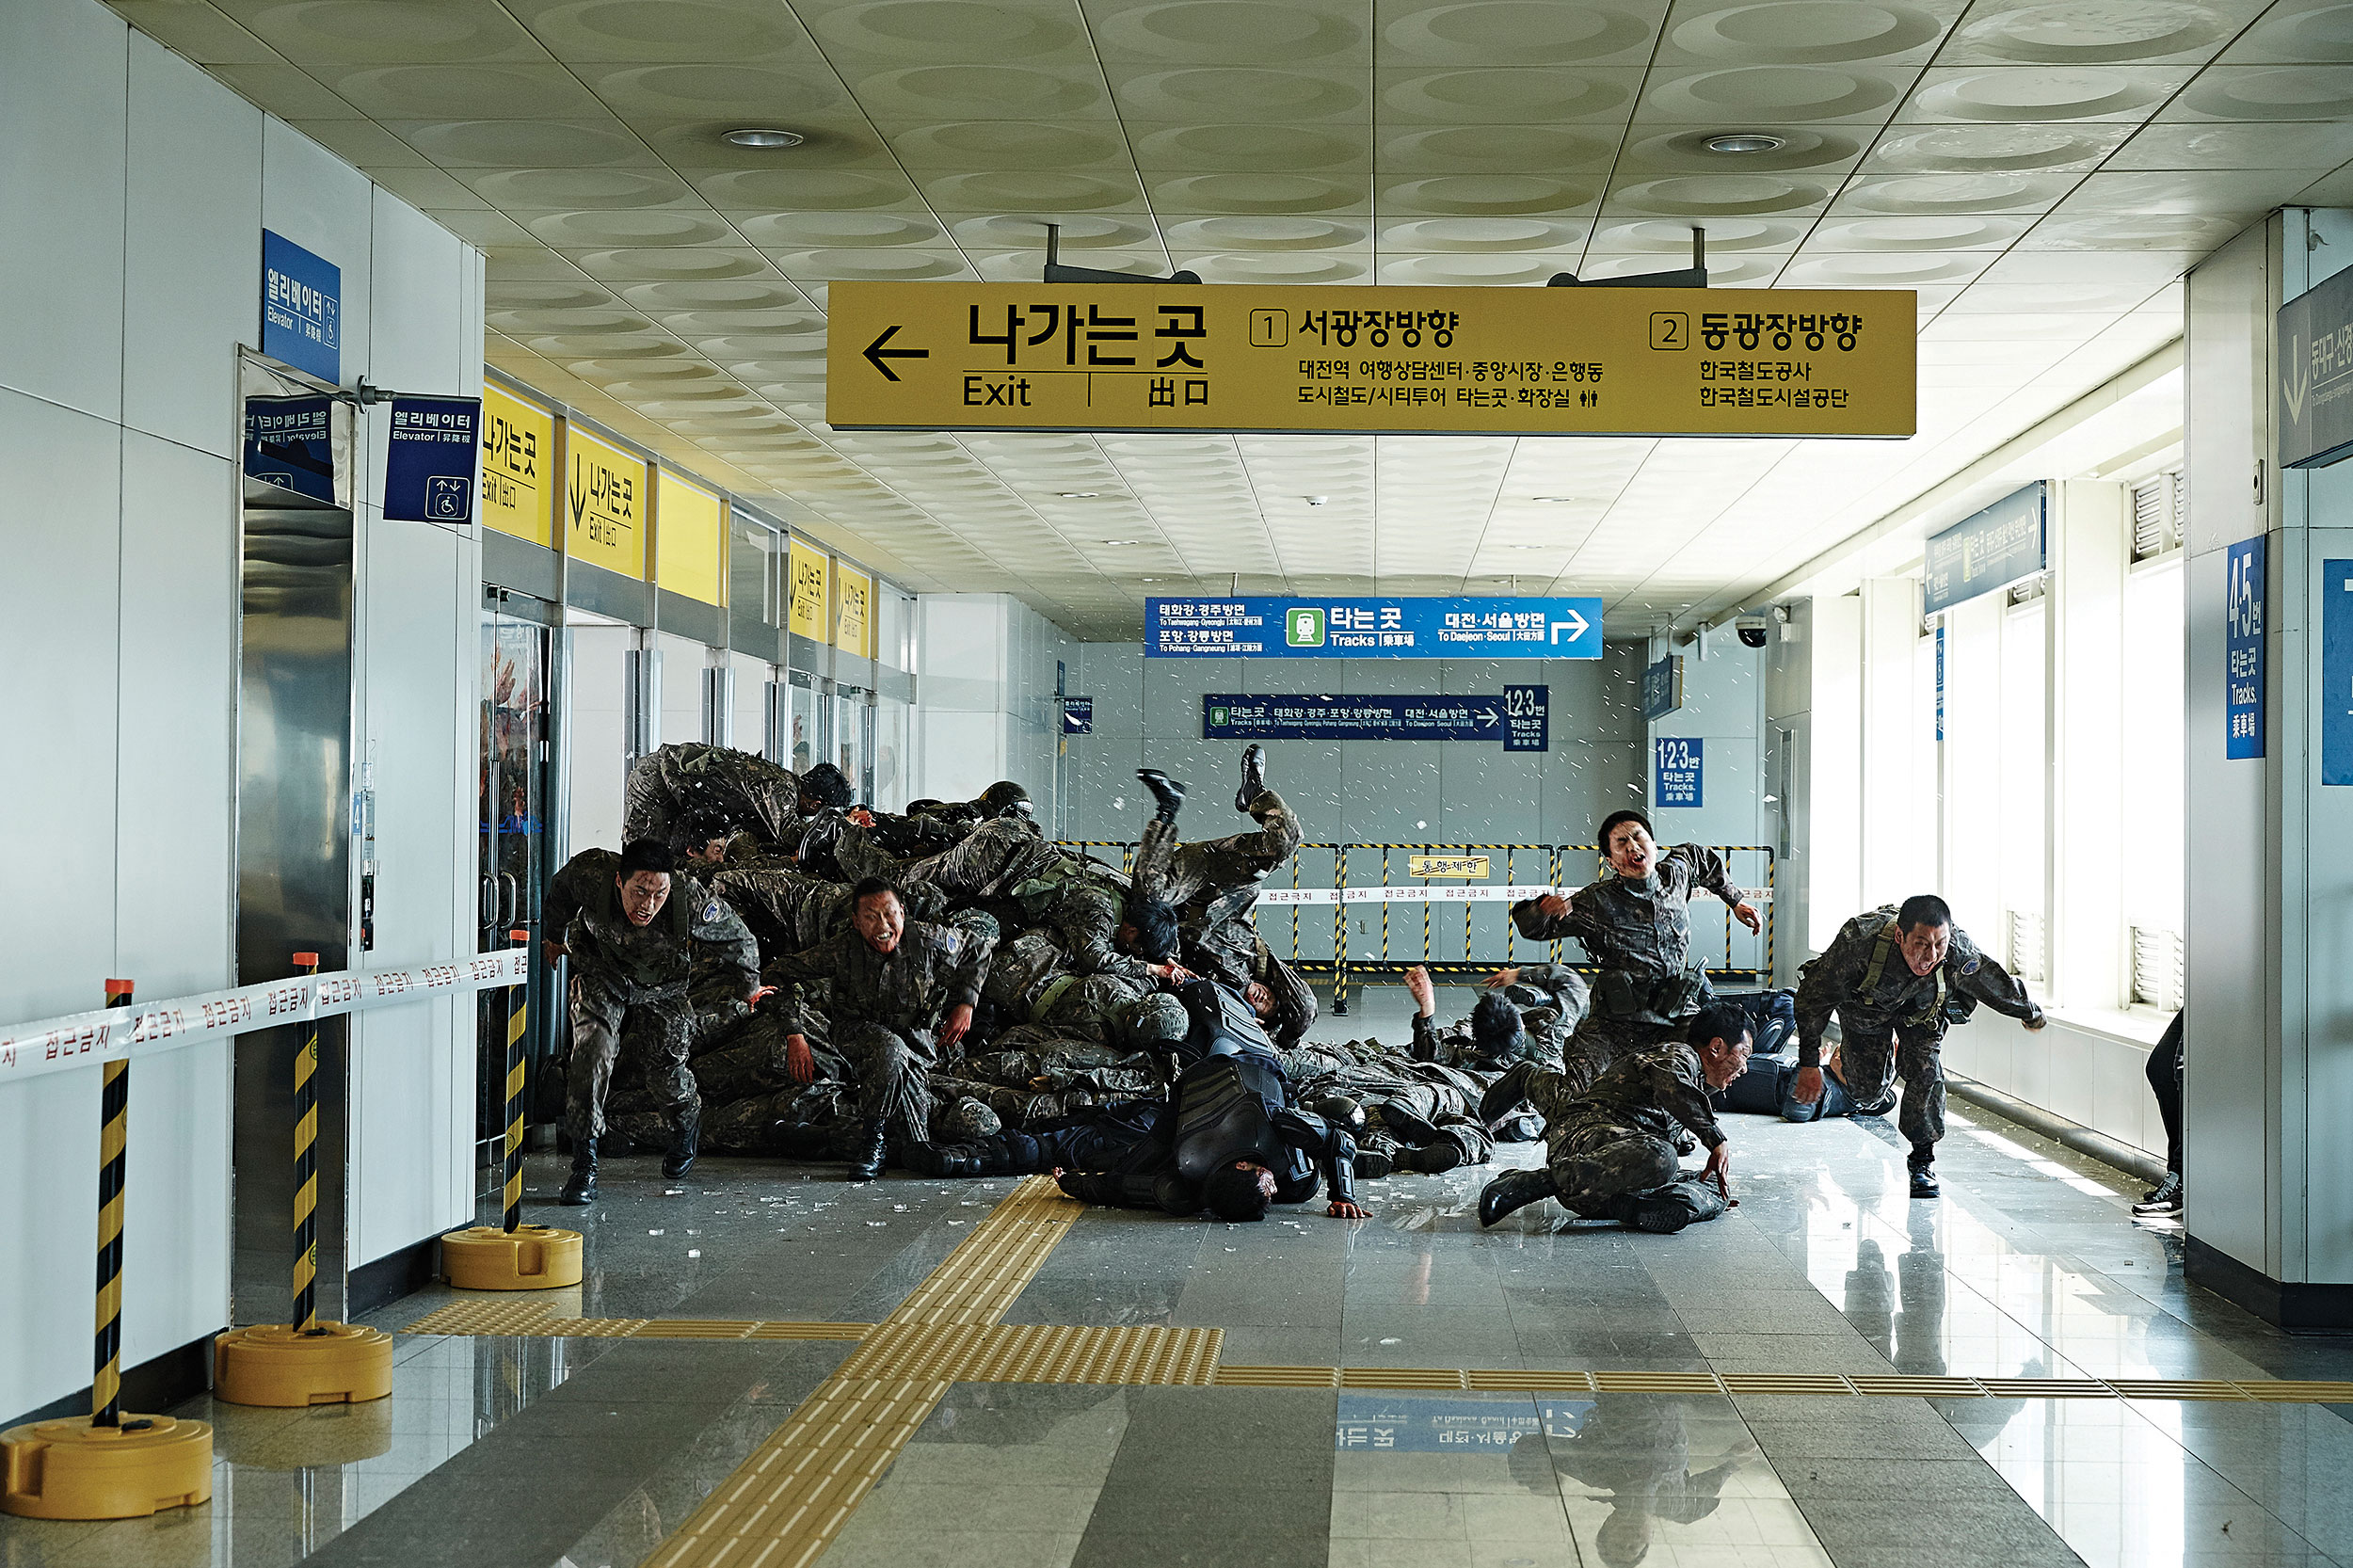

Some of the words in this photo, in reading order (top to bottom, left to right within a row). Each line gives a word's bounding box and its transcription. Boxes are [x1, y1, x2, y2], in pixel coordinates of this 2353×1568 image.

[267, 267, 322, 322] 엘리베이터
[267, 305, 294, 330] Elevator
[1298, 309, 1460, 348] 서광장방향
[968, 303, 1139, 366] 나가는
[1154, 304, 1208, 369] 곳
[1700, 312, 1863, 352] 동광장방향
[2312, 323, 2353, 380] 동대구·신경
[1298, 360, 1350, 380] 대전역
[1700, 360, 1812, 382] 한국철도공사
[963, 375, 1032, 407] Exit
[1147, 377, 1209, 408] 出口
[1297, 385, 1447, 407] 도시철도/시티투어
[1699, 386, 1849, 409] 한국철도시설공단
[393, 410, 471, 429] 엘리베이터
[392, 430, 436, 443] Elevator
[589, 516, 601, 544] Exit
[1160, 644, 1167, 652] To
[1330, 632, 1376, 648] Tracks
[1437, 631, 1449, 642] To
[2231, 647, 2257, 679] 타는곳
[1510, 719, 1542, 729] 타는곳
[1663, 772, 1695, 782] 타는곳
[1268, 891, 1313, 902] 접근금지
[1385, 888, 1429, 898] 접근금지
[1445, 888, 1489, 898] 접근금지
[45, 1021, 110, 1061] 접근금지
[201, 995, 251, 1029] 접근금지
[267, 984, 309, 1016] 접근금지
[320, 977, 362, 1006] 접근금지
[374, 970, 414, 996] 접근금지
[422, 963, 461, 987] 접근금지
[470, 957, 504, 982] 접근금지
